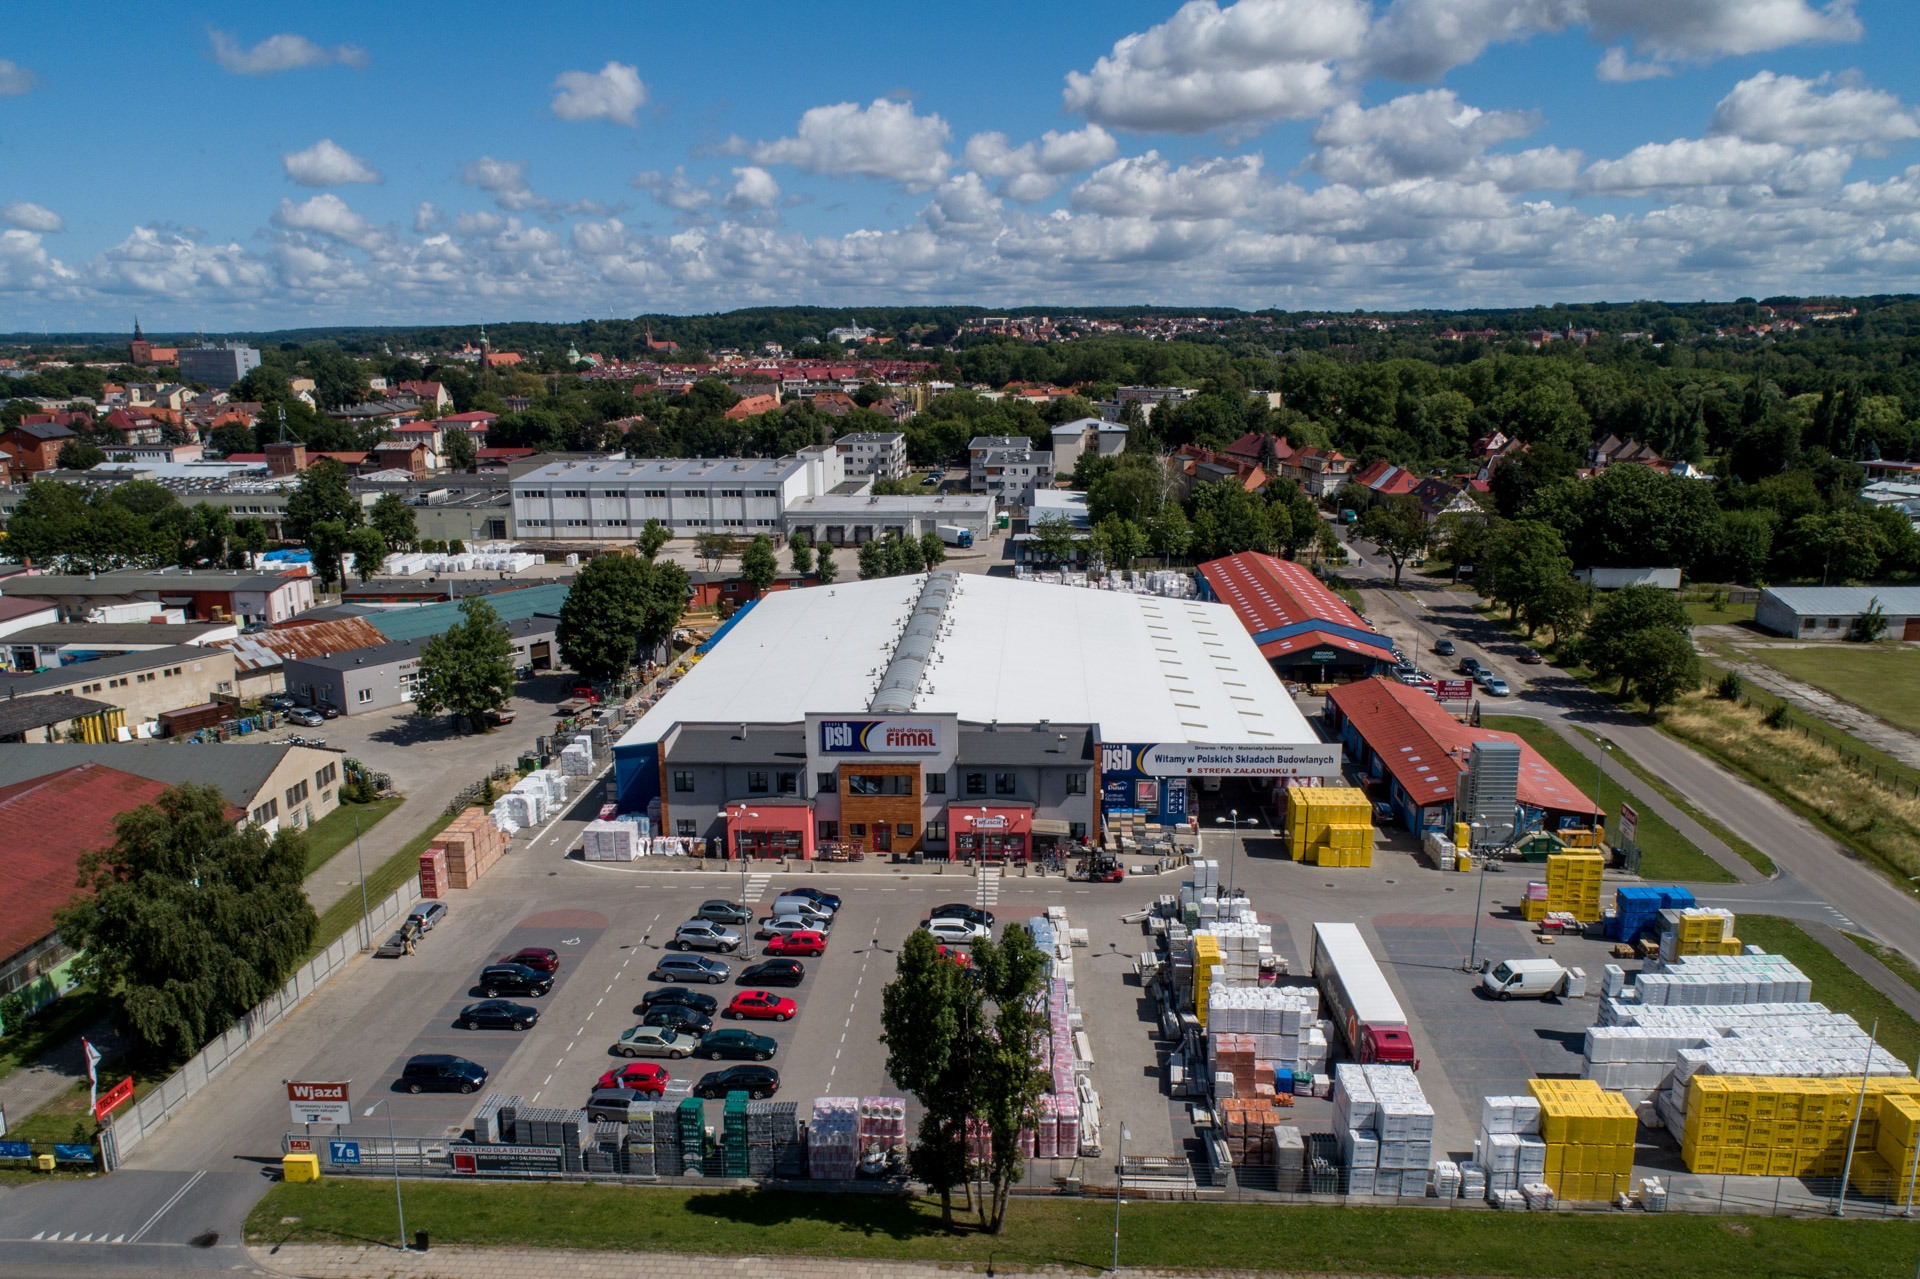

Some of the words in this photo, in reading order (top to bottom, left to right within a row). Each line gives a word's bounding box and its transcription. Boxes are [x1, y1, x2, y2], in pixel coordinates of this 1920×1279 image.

[825, 722, 852, 750] psb
[1102, 745, 1132, 774] psb
[1155, 755, 1186, 765] Witamy
[1197, 755, 1233, 764] Polskich
[1235, 755, 1274, 764] Składach
[1277, 755, 1334, 765] Budowlanych
[293, 1086, 342, 1100] Wjazd
[334, 1144, 355, 1157] 7B
